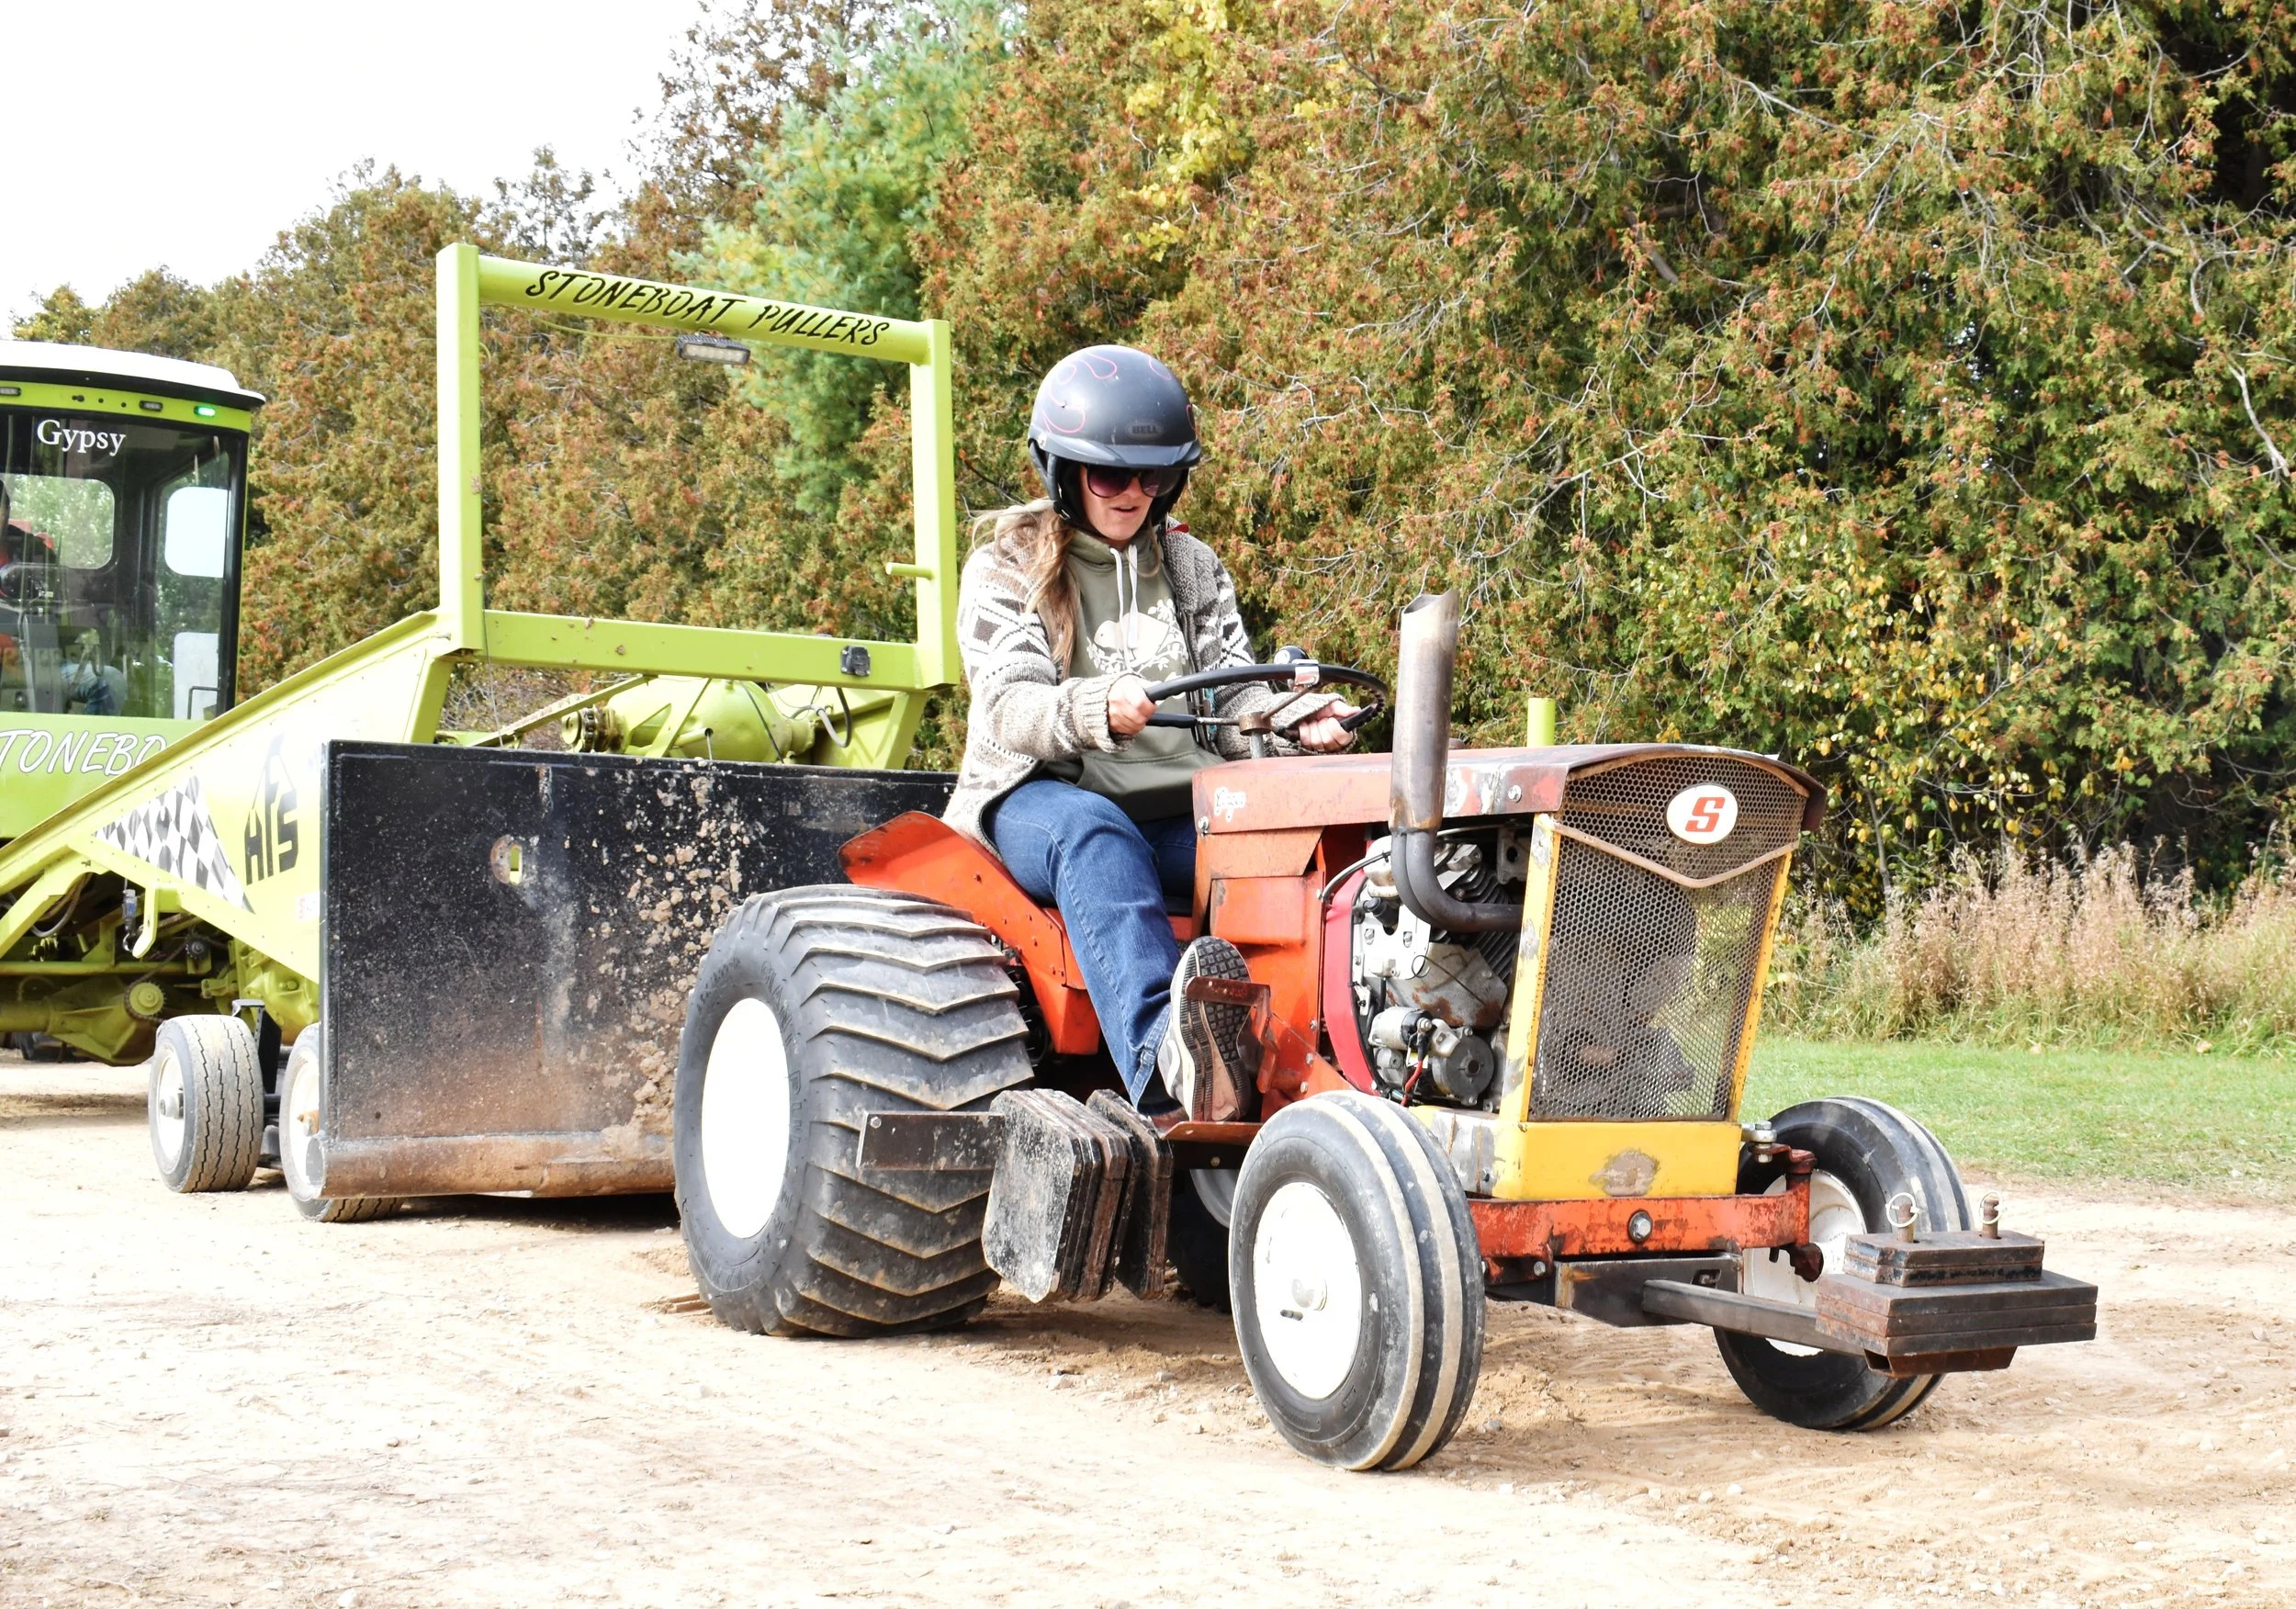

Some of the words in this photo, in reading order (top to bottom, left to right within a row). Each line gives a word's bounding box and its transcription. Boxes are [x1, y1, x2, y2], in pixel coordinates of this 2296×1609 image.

[524, 270, 747, 324] STONEBOAT
[748, 304, 890, 345] PULLERS
[37, 419, 126, 456] Gypsy
[1684, 796, 1726, 833] S
